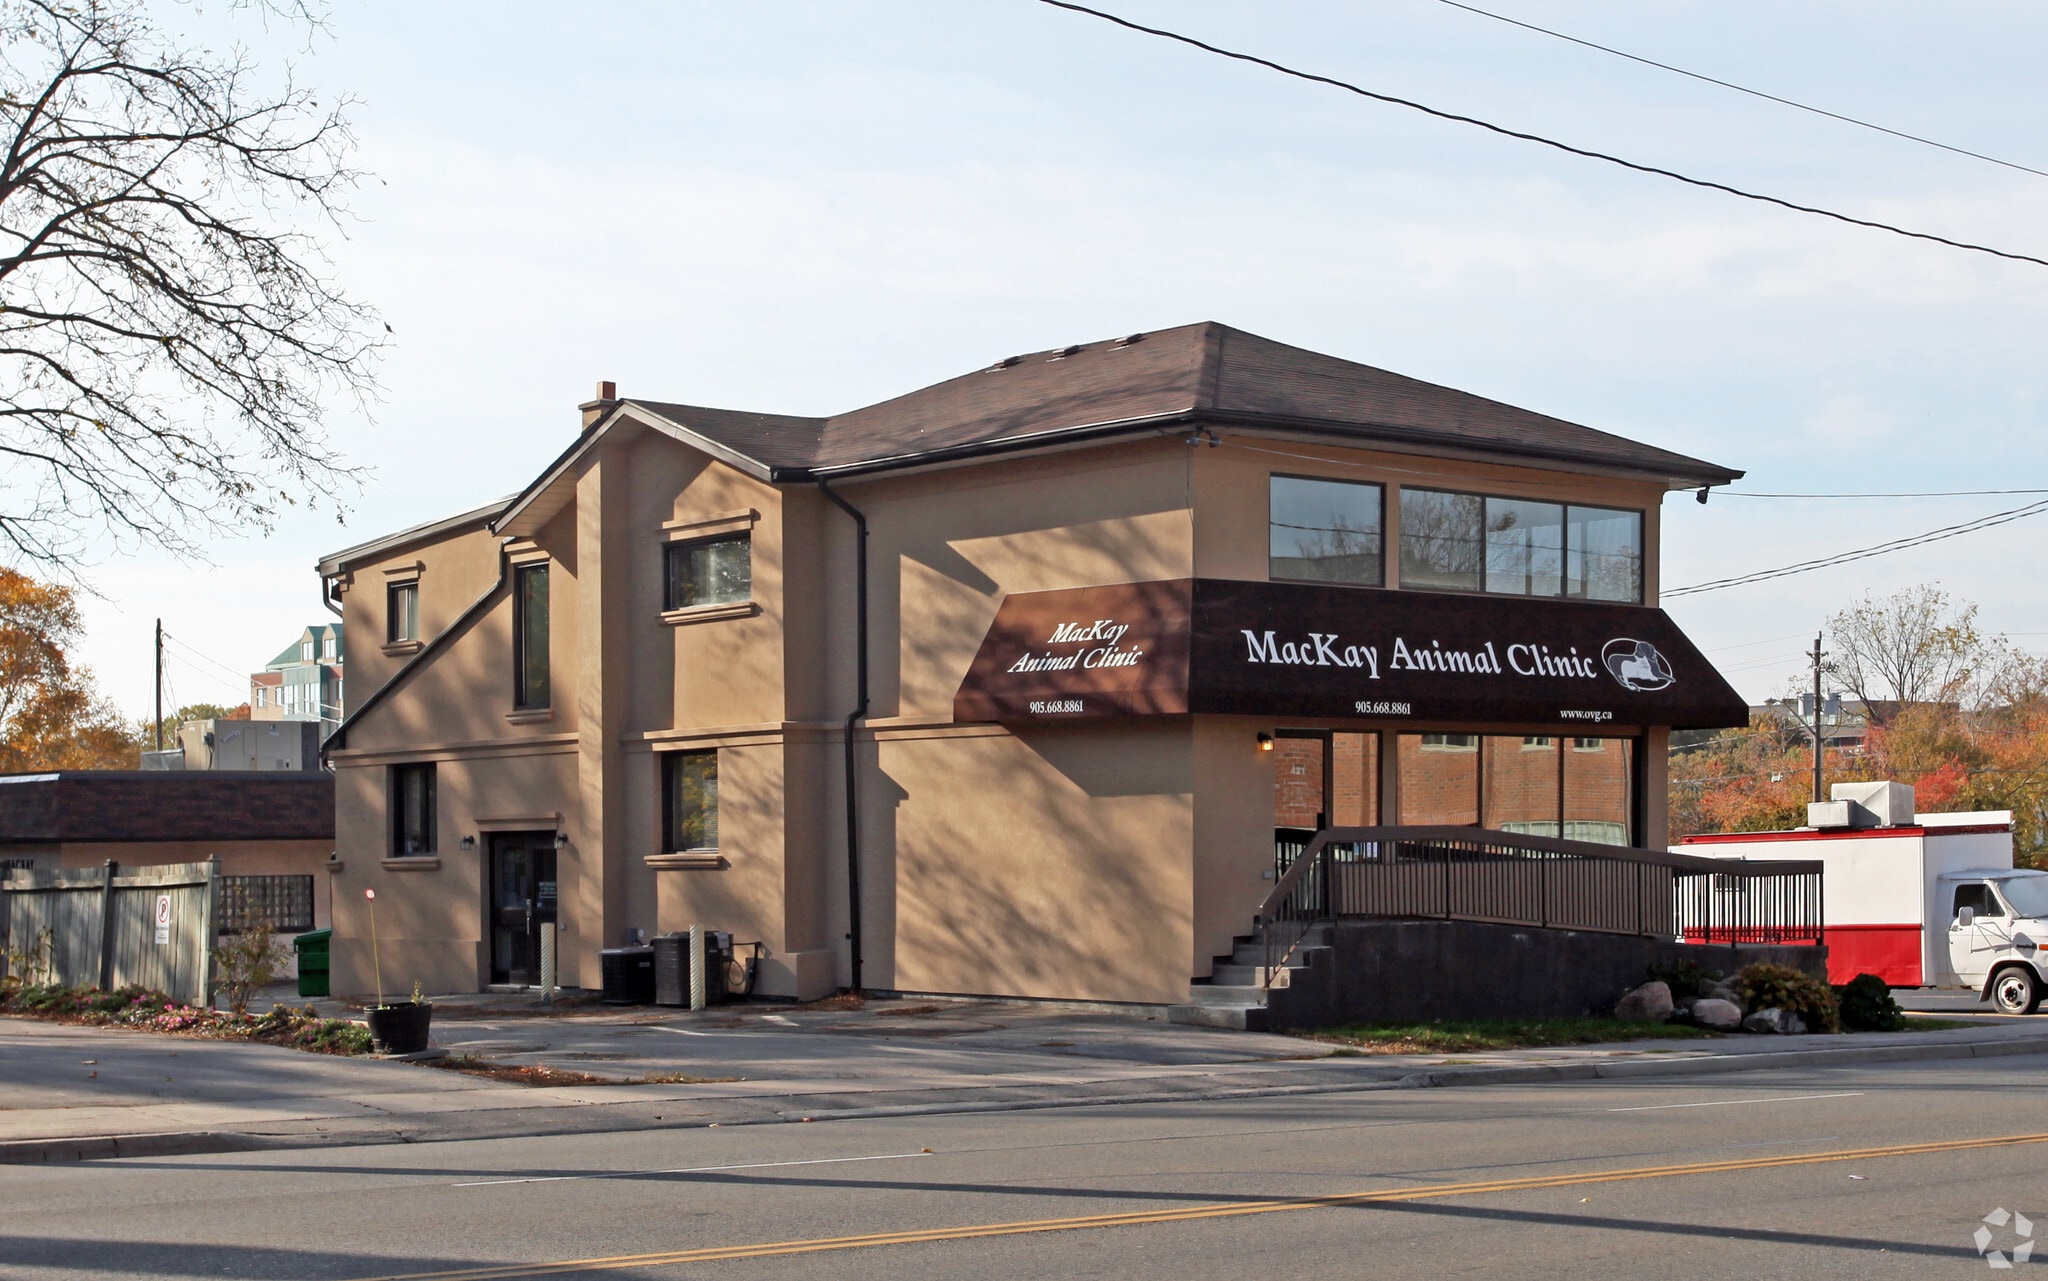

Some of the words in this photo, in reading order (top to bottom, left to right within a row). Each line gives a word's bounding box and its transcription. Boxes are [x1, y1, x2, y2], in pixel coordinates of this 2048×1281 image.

[1047, 619, 1130, 646] MacKay
[1007, 648, 1084, 673] Animal
[1083, 644, 1144, 669] Clinic
[1240, 629, 1381, 679] MacKay
[1389, 637, 1502, 675] Animal
[1507, 643, 1598, 679] Clinic
[1029, 700, 1084, 714] 905.668.8861
[1355, 701, 1411, 715] 905.668.8861
[1560, 710, 1613, 723] www.ovg.ca
